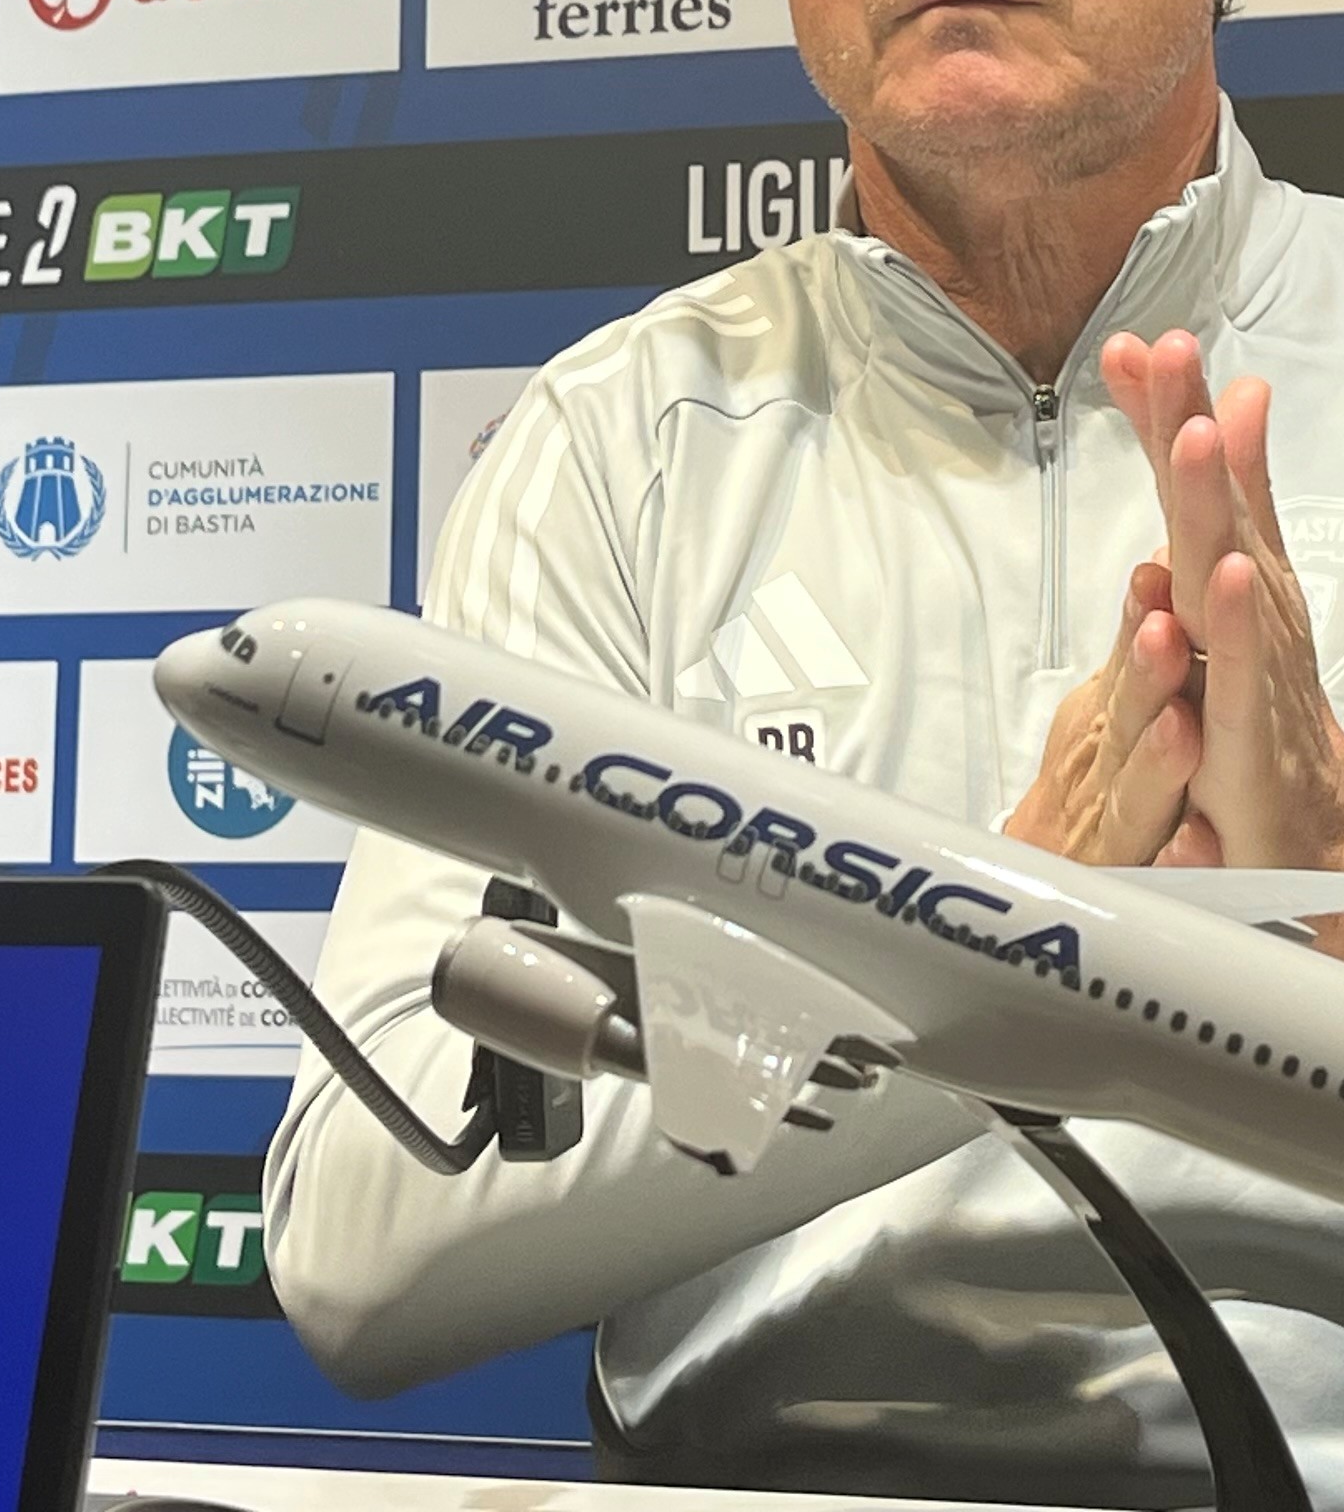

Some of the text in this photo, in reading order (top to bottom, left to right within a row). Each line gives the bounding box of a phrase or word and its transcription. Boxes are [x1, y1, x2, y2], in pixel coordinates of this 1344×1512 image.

[688, 157, 845, 254] LIGU
[22, 185, 77, 285] 2
[93, 203, 290, 264] BKT
[148, 451, 265, 480] CUMUNITÀ
[147, 481, 380, 507] D'AGGLUMERAZIONE
[147, 512, 256, 535] DI BASTIA
[187, 748, 225, 810] zili
[364, 676, 1081, 992] AIR CORSICA
[157, 974, 224, 998] ETTIVITÀ
[157, 1004, 235, 1027] LLECTIVITÉ
[239, 1011, 257, 1027] DE
[124, 1208, 263, 1269] KT
